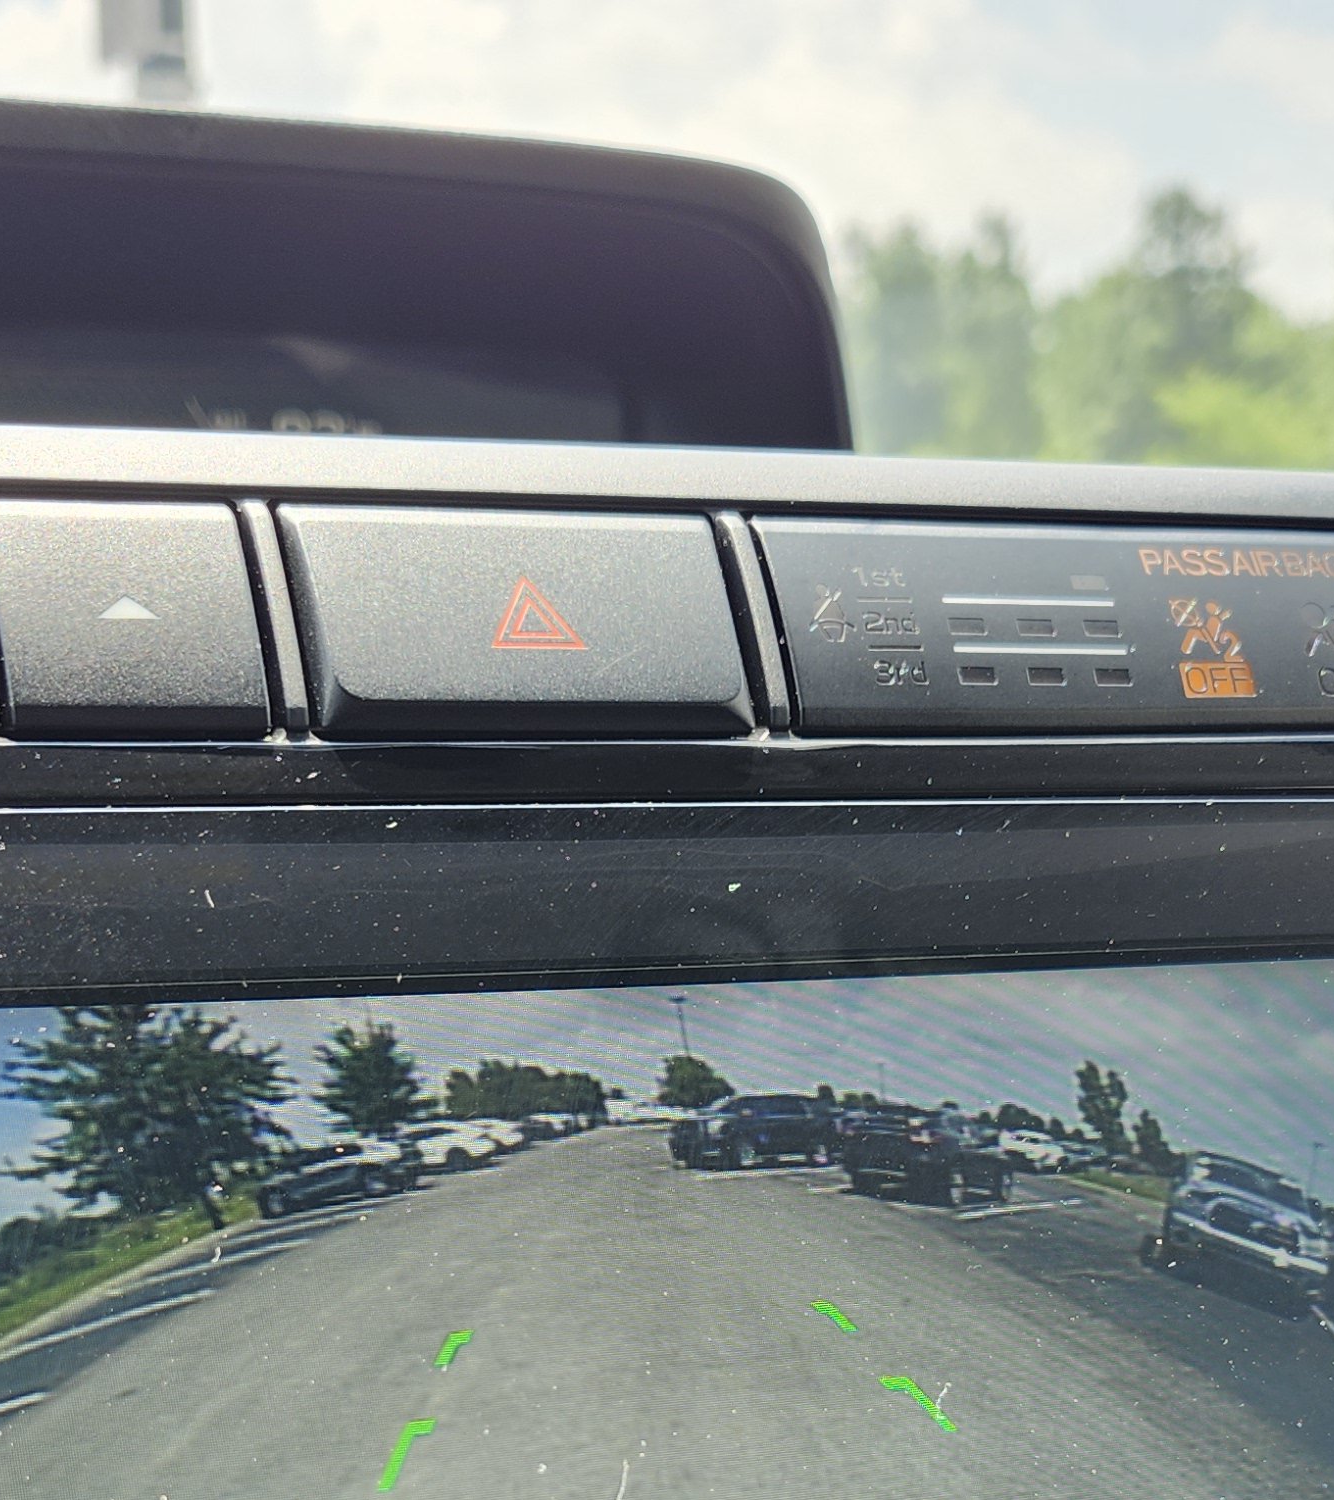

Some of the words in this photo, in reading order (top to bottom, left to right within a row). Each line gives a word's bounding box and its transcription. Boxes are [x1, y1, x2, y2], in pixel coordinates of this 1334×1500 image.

[1138, 547, 1230, 577] PASS
[851, 566, 906, 588] 1st
[861, 610, 920, 635] 2nd
[873, 659, 929, 686] 3rd
[1185, 666, 1247, 696] OFF
